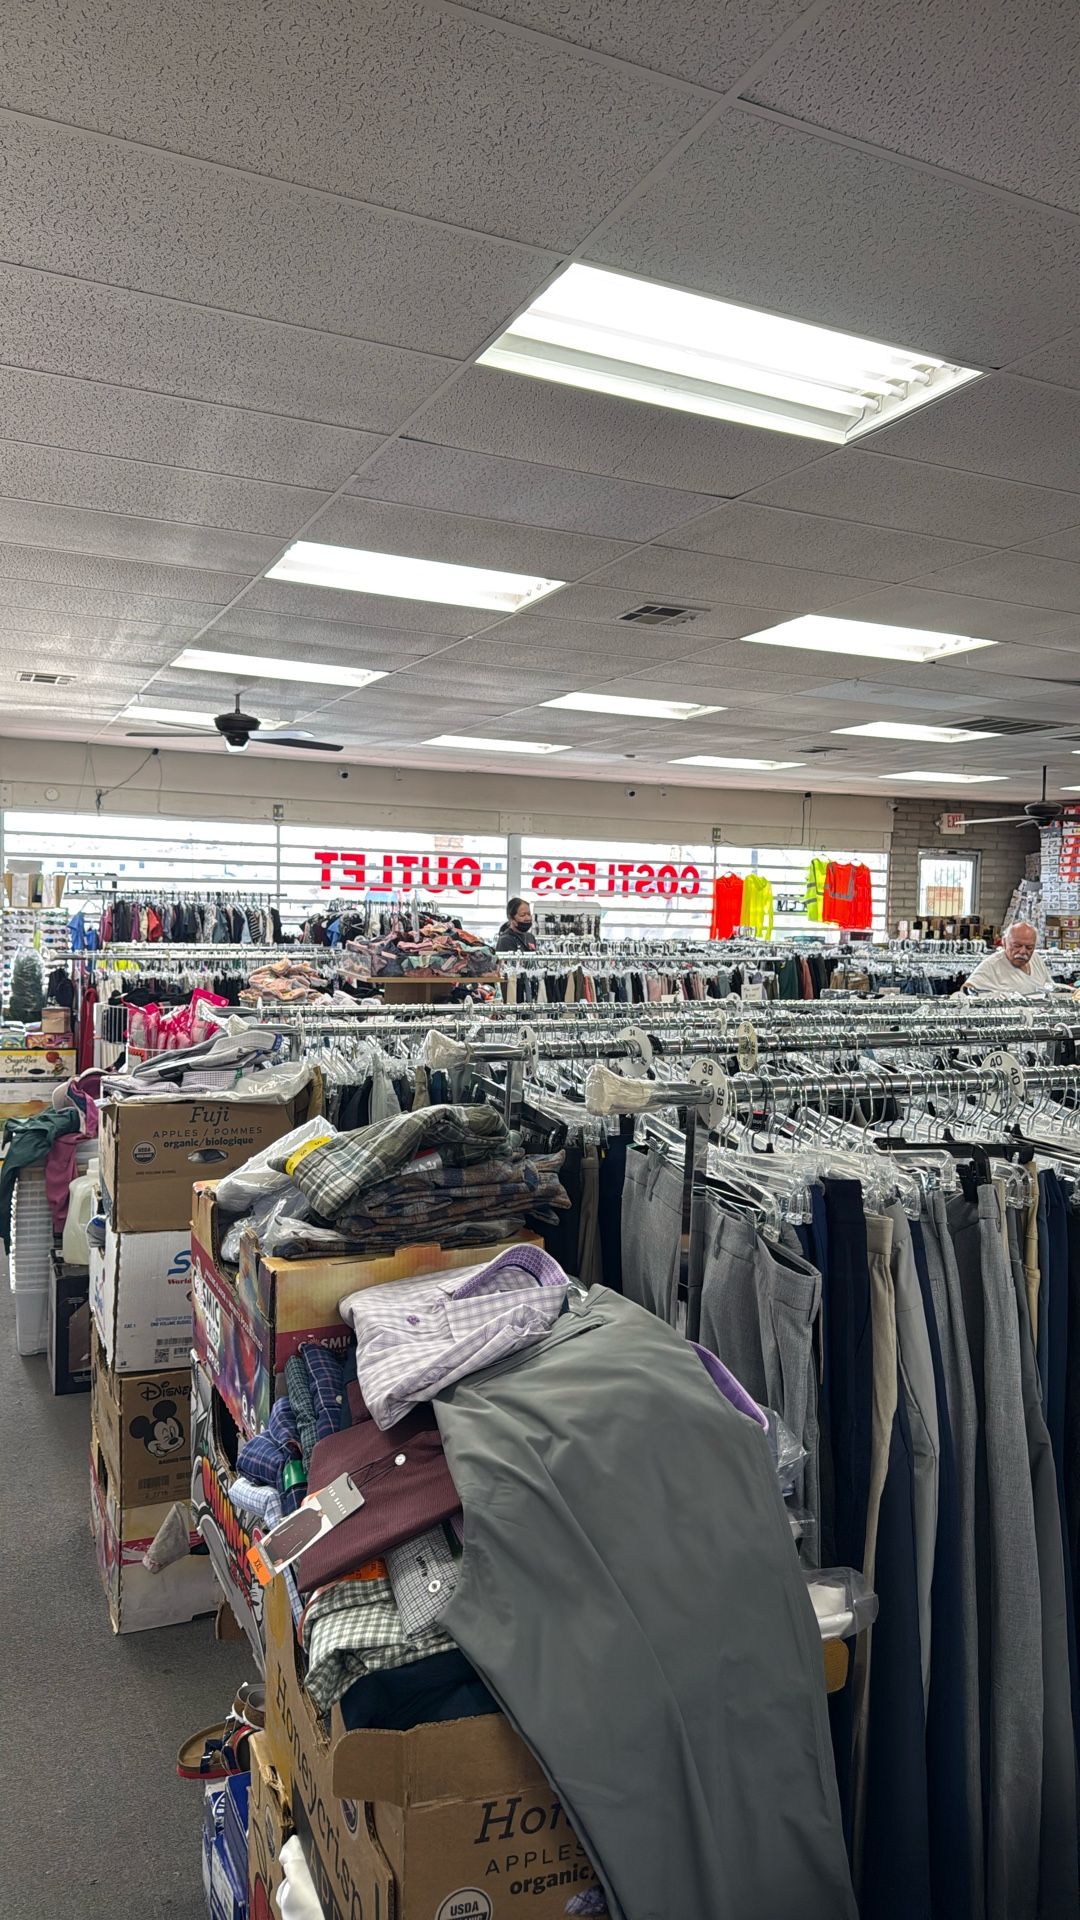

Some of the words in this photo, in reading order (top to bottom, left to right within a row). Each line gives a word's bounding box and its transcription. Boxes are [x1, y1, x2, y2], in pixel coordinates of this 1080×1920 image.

[989, 1055, 1003, 1068] 40
[701, 1062, 714, 1076] 38
[1009, 1067, 1021, 1086] 40
[717, 1087, 725, 1107] 38
[189, 1106, 230, 1126] Fuji
[153, 1129, 198, 1138] APPLES
[214, 1126, 263, 1136] POMMES
[253, 1559, 263, 1570] XXL
[450, 1901, 479, 1916] USDA
